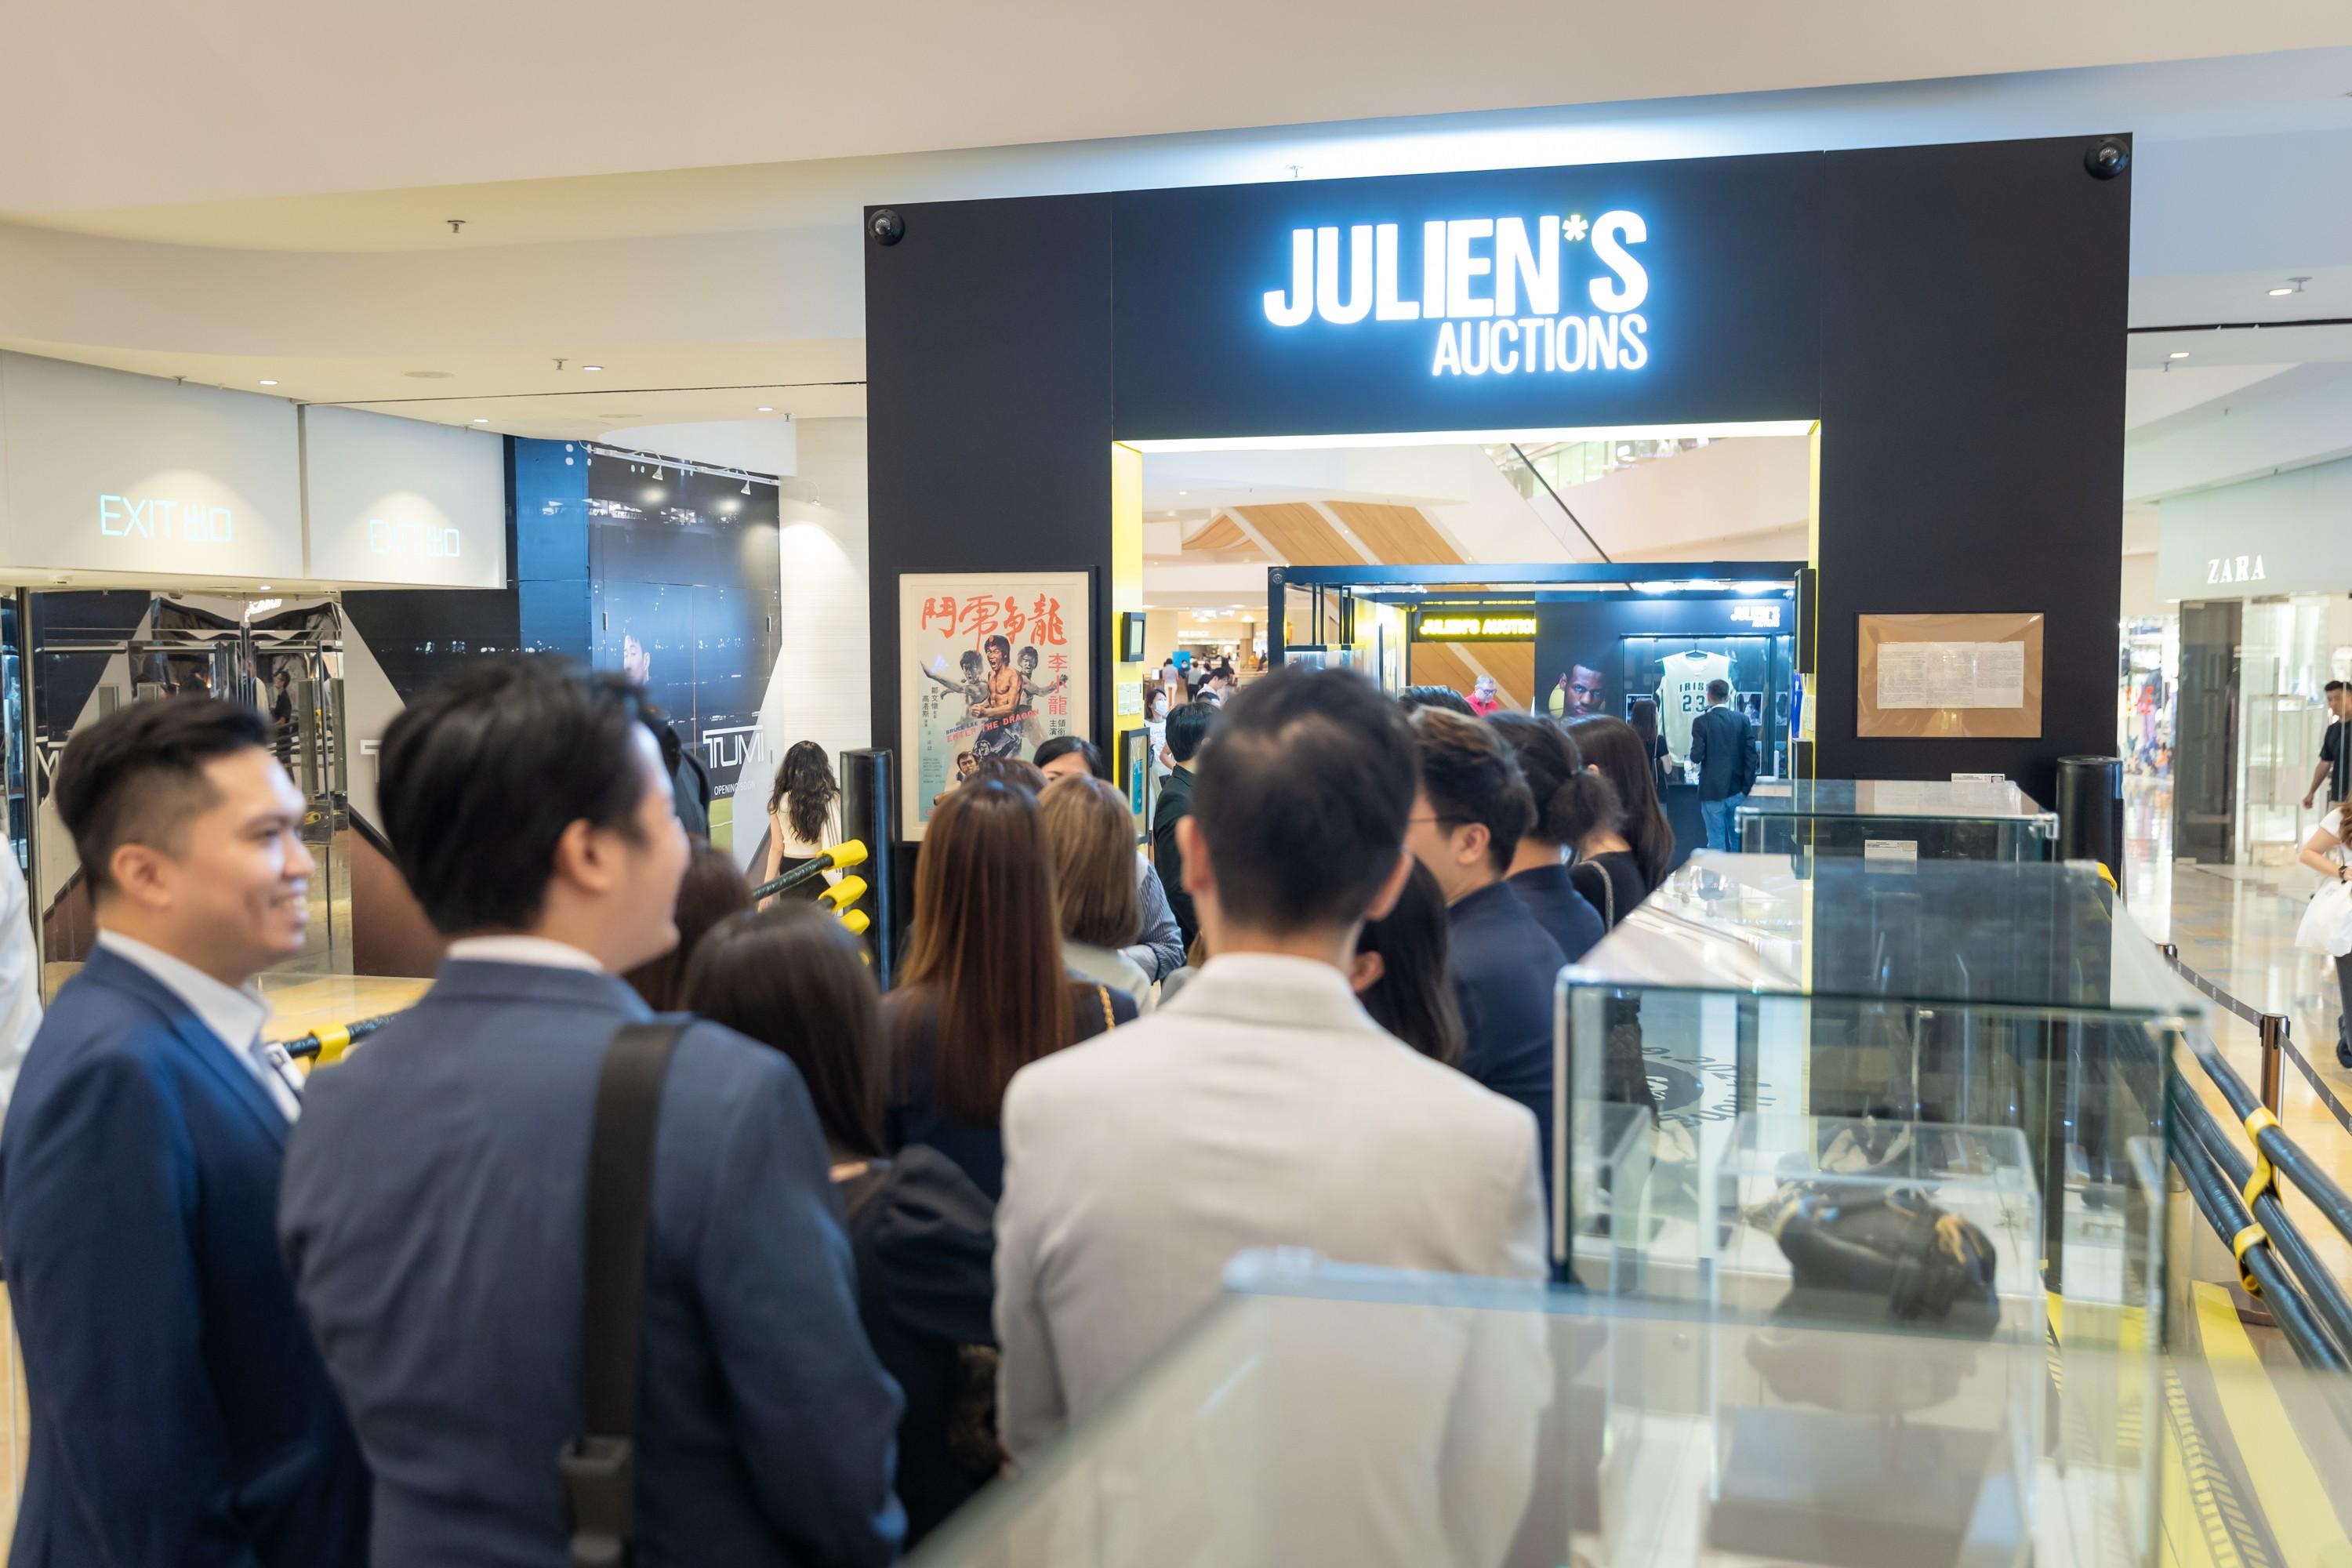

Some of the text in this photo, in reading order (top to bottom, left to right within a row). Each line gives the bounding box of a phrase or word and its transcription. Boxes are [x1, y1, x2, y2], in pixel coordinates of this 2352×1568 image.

[1432, 313, 1648, 376] AUCTIONS
[100, 494, 233, 543] EXIT 出口
[368, 518, 461, 557] EXIT 出口
[2207, 554, 2267, 584] ZARA
[1047, 652, 1068, 715] 李小龍
[1679, 682, 1709, 692] IRIS
[1682, 694, 1706, 713] 23
[946, 727, 977, 742] ENTER
[980, 720, 1000, 732] THE
[1002, 708, 1040, 726] DRAGON
[946, 724, 966, 735] BRUCE
[702, 724, 764, 769] TUMI
[713, 782, 739, 796] OPENING
